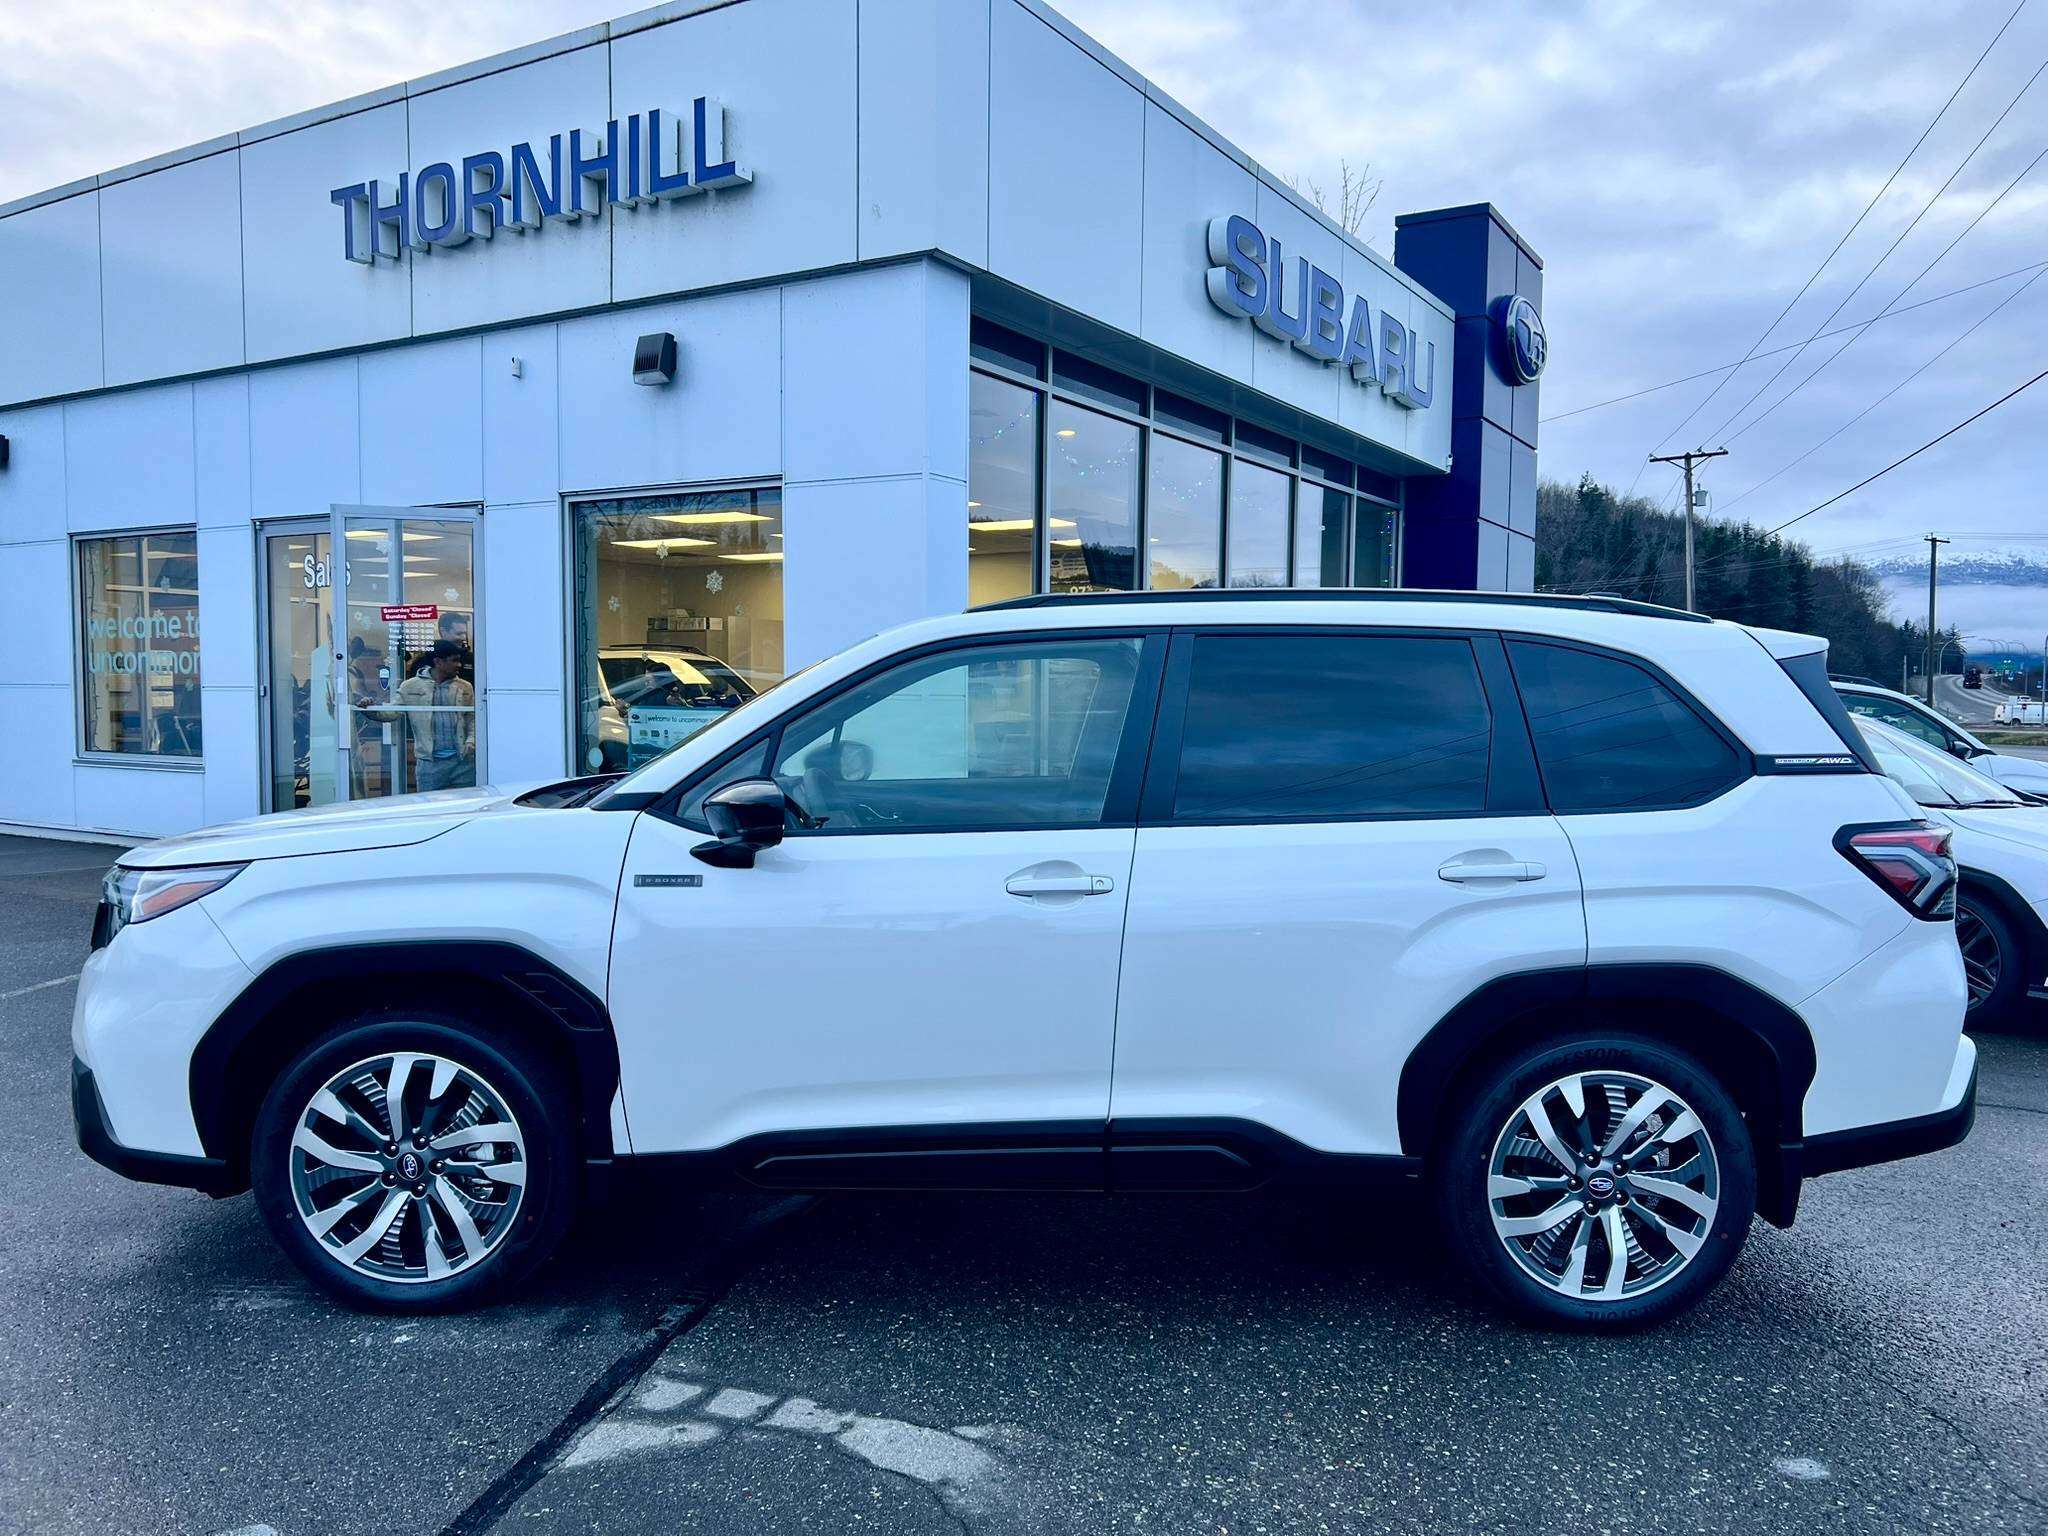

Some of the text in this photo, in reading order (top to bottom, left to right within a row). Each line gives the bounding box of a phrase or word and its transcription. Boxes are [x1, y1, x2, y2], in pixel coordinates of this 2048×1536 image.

[330, 96, 752, 264] THORNHILL
[1207, 213, 1435, 409] SUBARU
[304, 554, 350, 588] Sals
[88, 608, 181, 639] welcome
[647, 714, 671, 722] welcome
